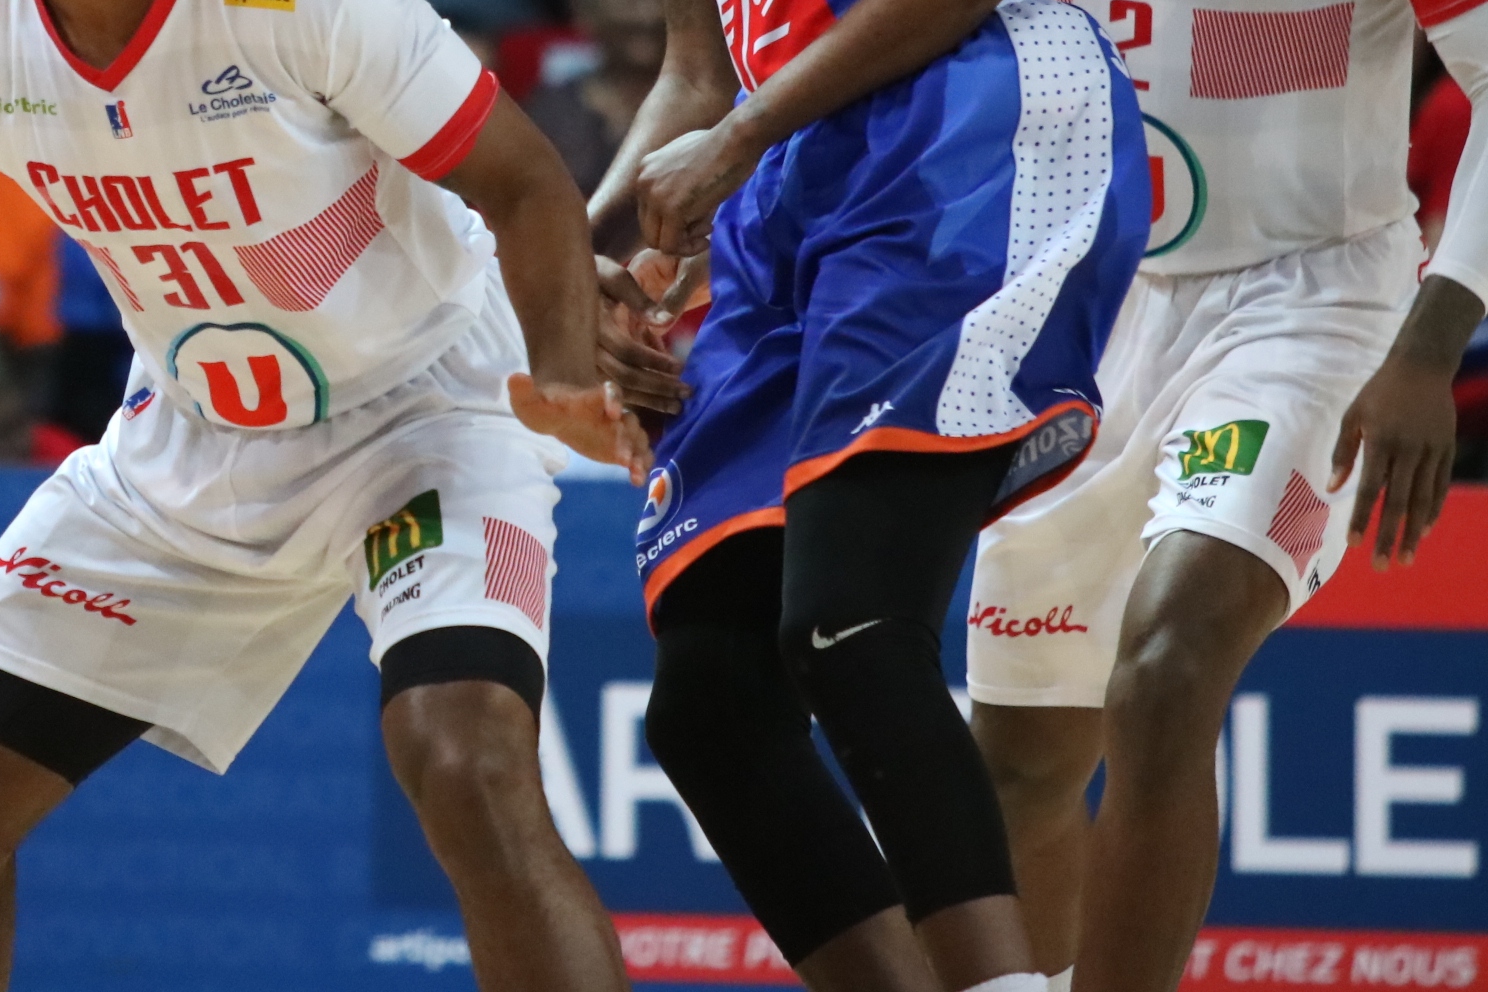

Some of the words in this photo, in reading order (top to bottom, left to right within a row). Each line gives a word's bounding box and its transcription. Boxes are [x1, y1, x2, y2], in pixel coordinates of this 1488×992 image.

[188, 102, 208, 115] Le
[209, 92, 277, 111] Choletais
[26, 157, 262, 232] CHOLET
[130, 241, 245, 310] 31
[197, 354, 288, 427] U
[379, 554, 425, 598] CHOLET
[968, 602, 1088, 637] Nicoll
[1223, 939, 1345, 987] CHEZ
[1349, 944, 1480, 989] NOUS
